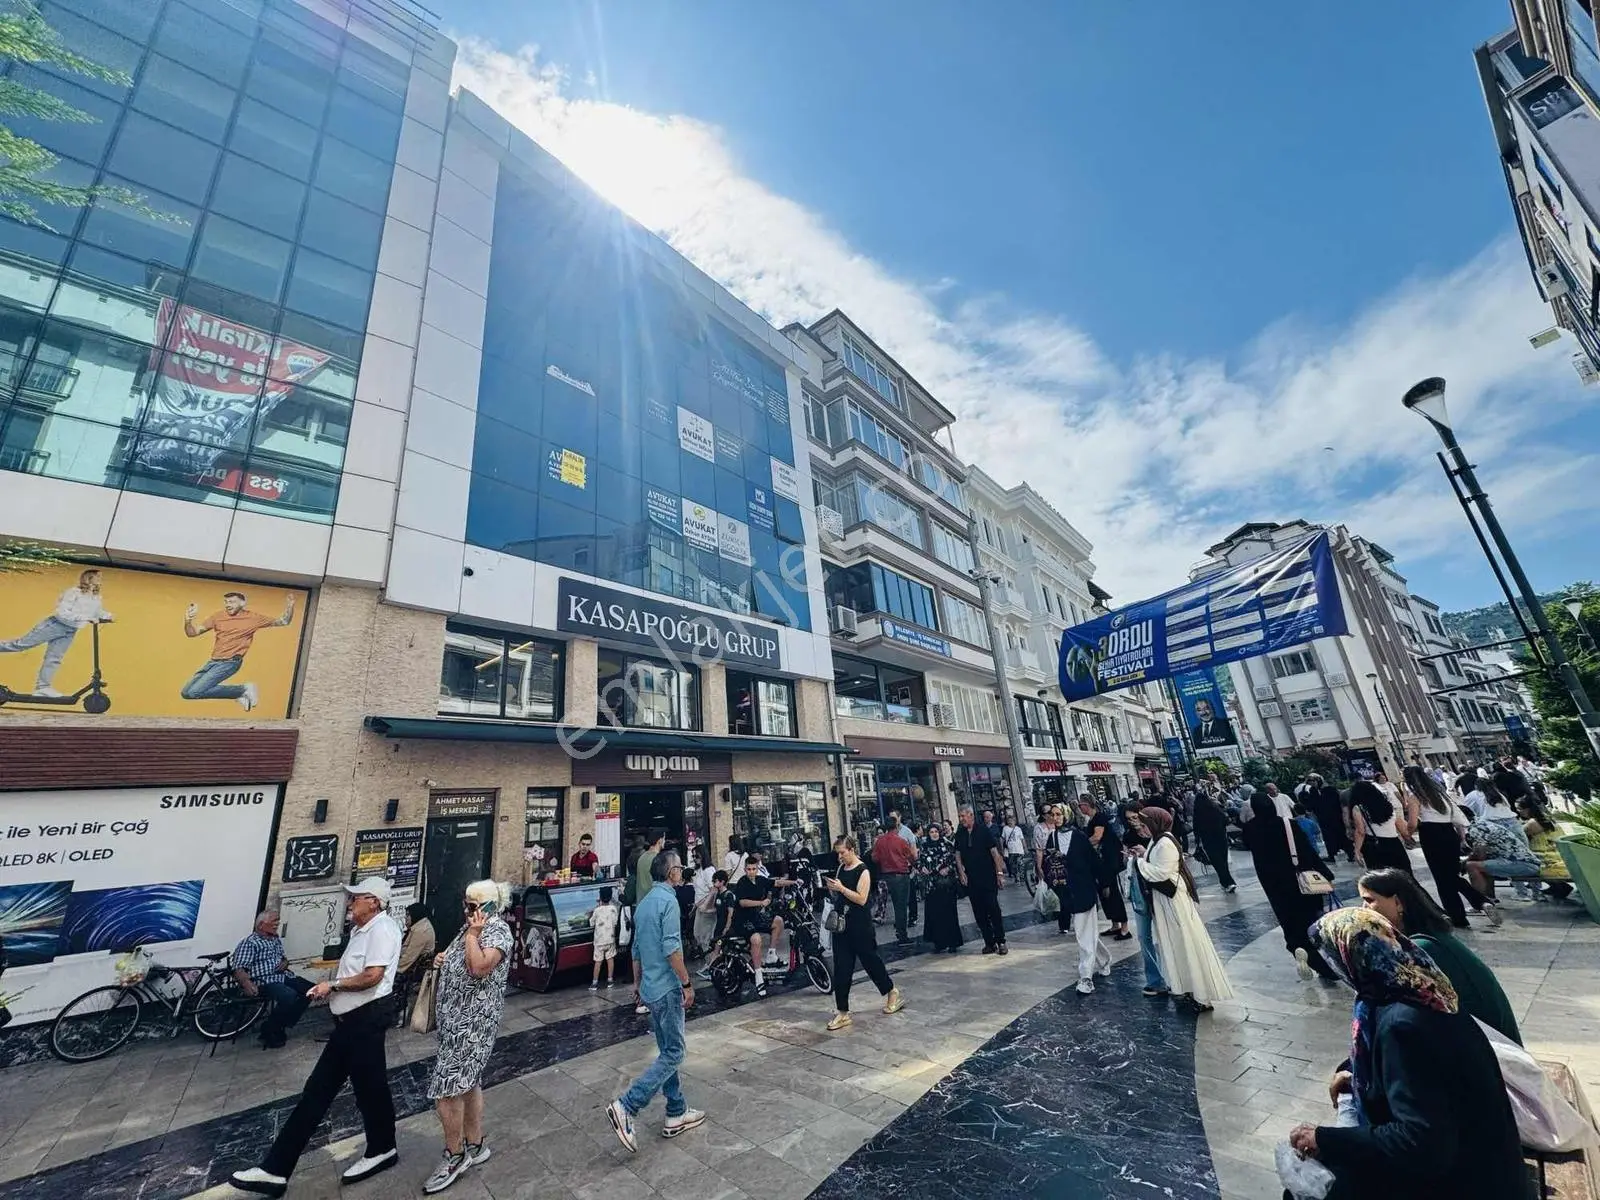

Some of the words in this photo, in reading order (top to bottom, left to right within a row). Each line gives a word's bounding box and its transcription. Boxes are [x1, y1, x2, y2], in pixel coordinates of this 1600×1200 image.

[681, 427, 713, 448] AVUKAT
[647, 489, 677, 507] AVUKAT
[684, 516, 716, 535] AVUKAT
[568, 594, 720, 650] KASAPOĞLU
[725, 631, 776, 660] GRUP
[1108, 619, 1153, 657] ORDU
[625, 754, 700, 779] unpam
[160, 792, 264, 809] SAMSUNG
[435, 797, 461, 805] AHMET
[461, 796, 486, 804] KASAP
[448, 805, 479, 815] MERKEZİ
[7, 825, 31, 838] ile
[38, 822, 78, 837] Yeni
[81, 821, 106, 835] Bir
[110, 819, 149, 836] Çağ
[362, 831, 403, 841] KASAPOĞLU
[391, 841, 421, 849] AVUKAT
[0, 854, 33, 868] LED
[36, 851, 57, 865] 8K
[69, 848, 114, 862] OLED
